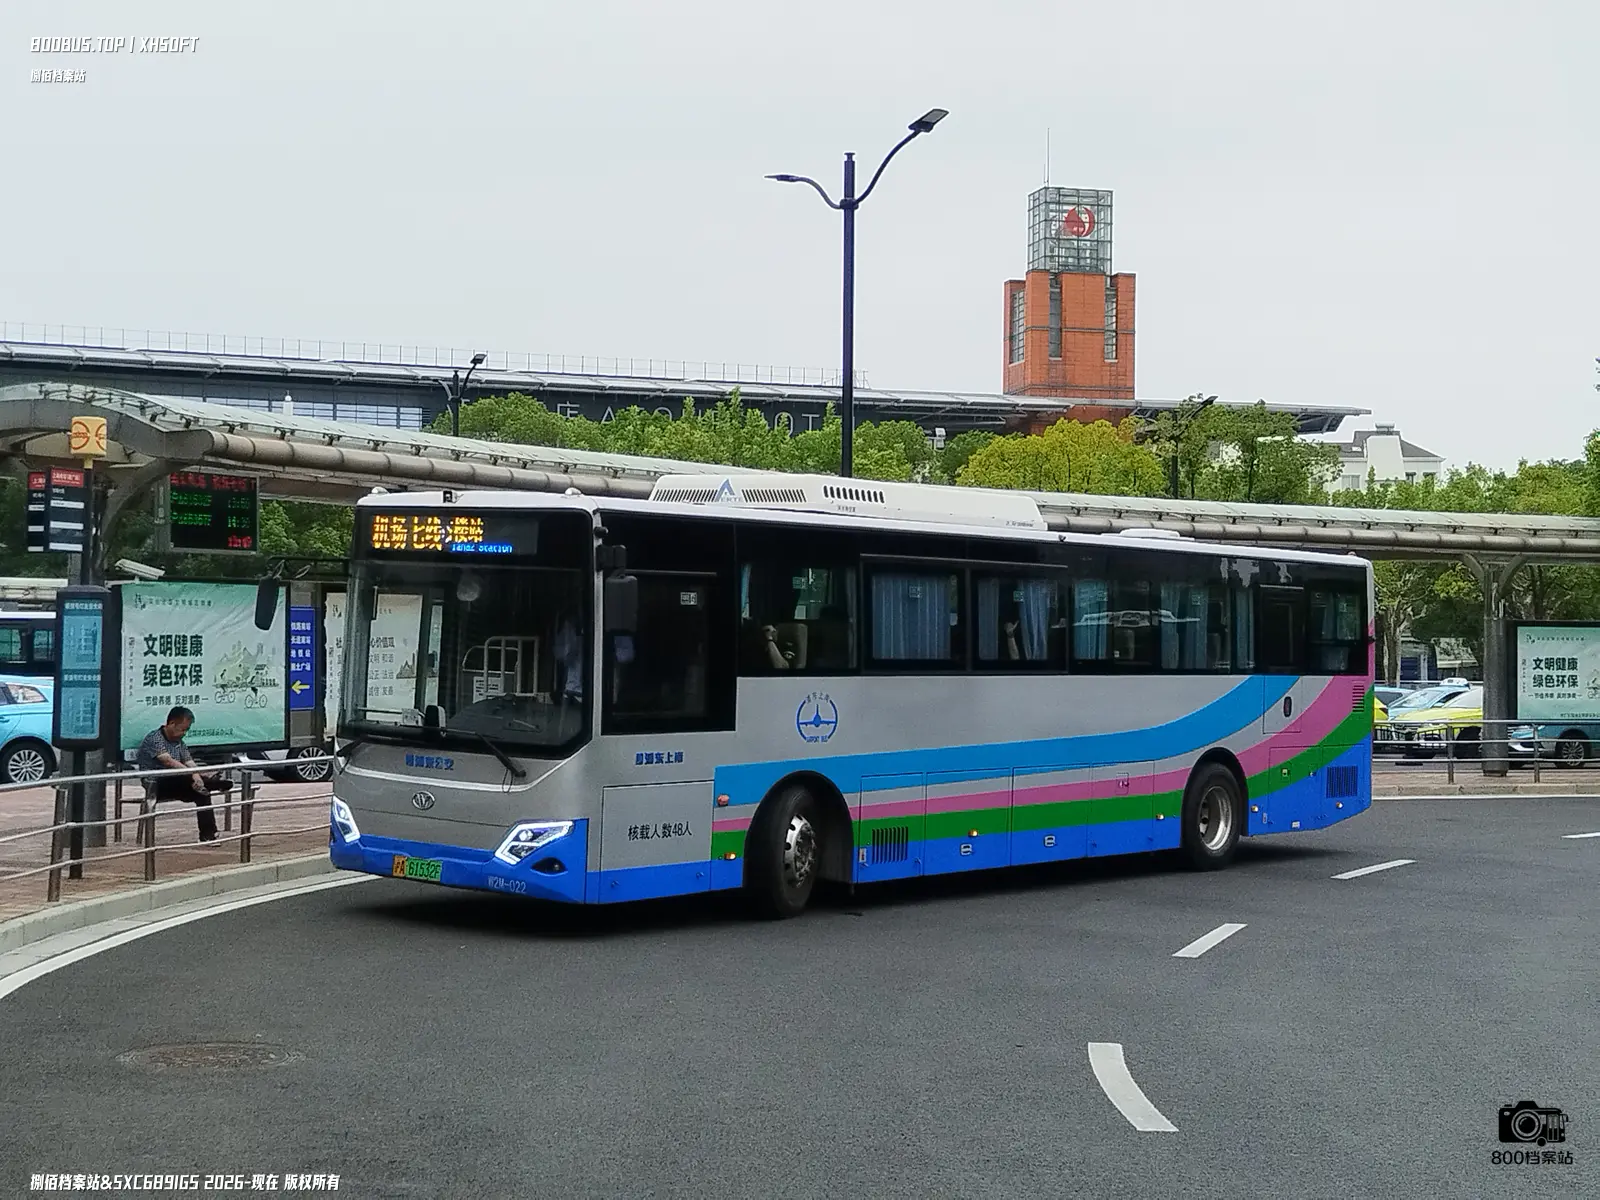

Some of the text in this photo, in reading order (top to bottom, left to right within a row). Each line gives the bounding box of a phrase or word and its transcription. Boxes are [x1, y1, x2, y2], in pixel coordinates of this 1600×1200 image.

[143, 633, 203, 657] 文明健康
[1532, 657, 1579, 671] 文明健康
[143, 663, 203, 687] 绿色环保
[1532, 674, 1579, 688] 绿色环保
[628, 821, 693, 841] 核载人数48人
